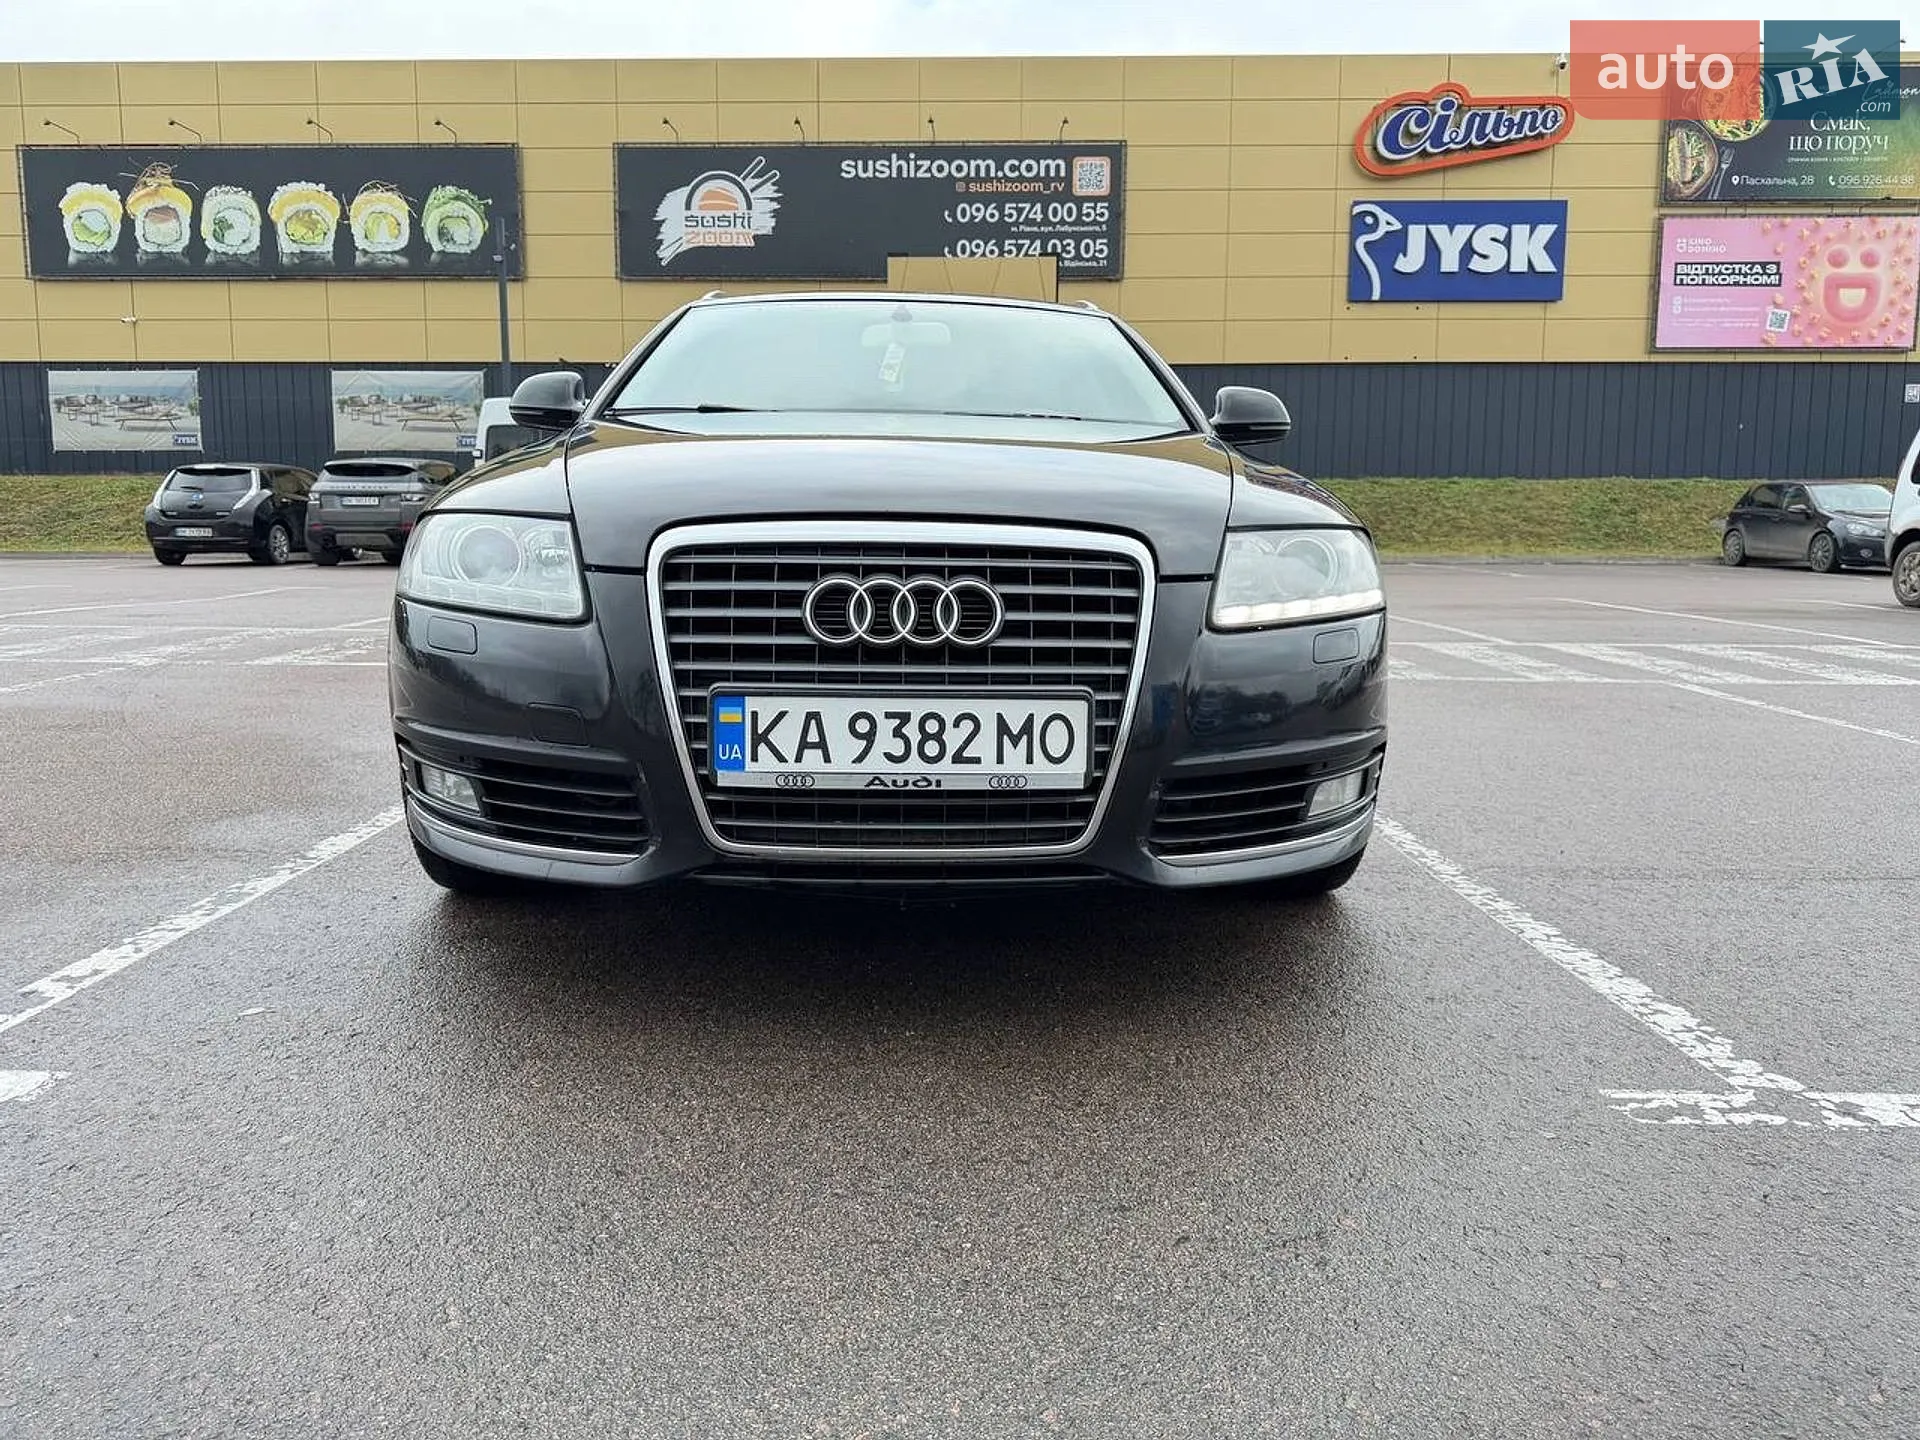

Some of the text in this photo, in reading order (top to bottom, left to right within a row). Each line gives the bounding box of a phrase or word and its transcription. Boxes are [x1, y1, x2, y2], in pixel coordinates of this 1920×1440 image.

[1376, 97, 1562, 160] Сільпо
[840, 153, 1066, 178] sushizoom.com
[968, 179, 1065, 193] sushizoom_rv
[956, 202, 1109, 223] 096 574 00 55
[956, 239, 1109, 258] 096 574 03 05
[1393, 223, 1559, 274] JYSK
[1675, 274, 1780, 285] ПОПКОРНОМ!
[1676, 264, 1764, 274] ВІДПУСТКА
[719, 710, 1076, 766] UA KA 9382 MO
